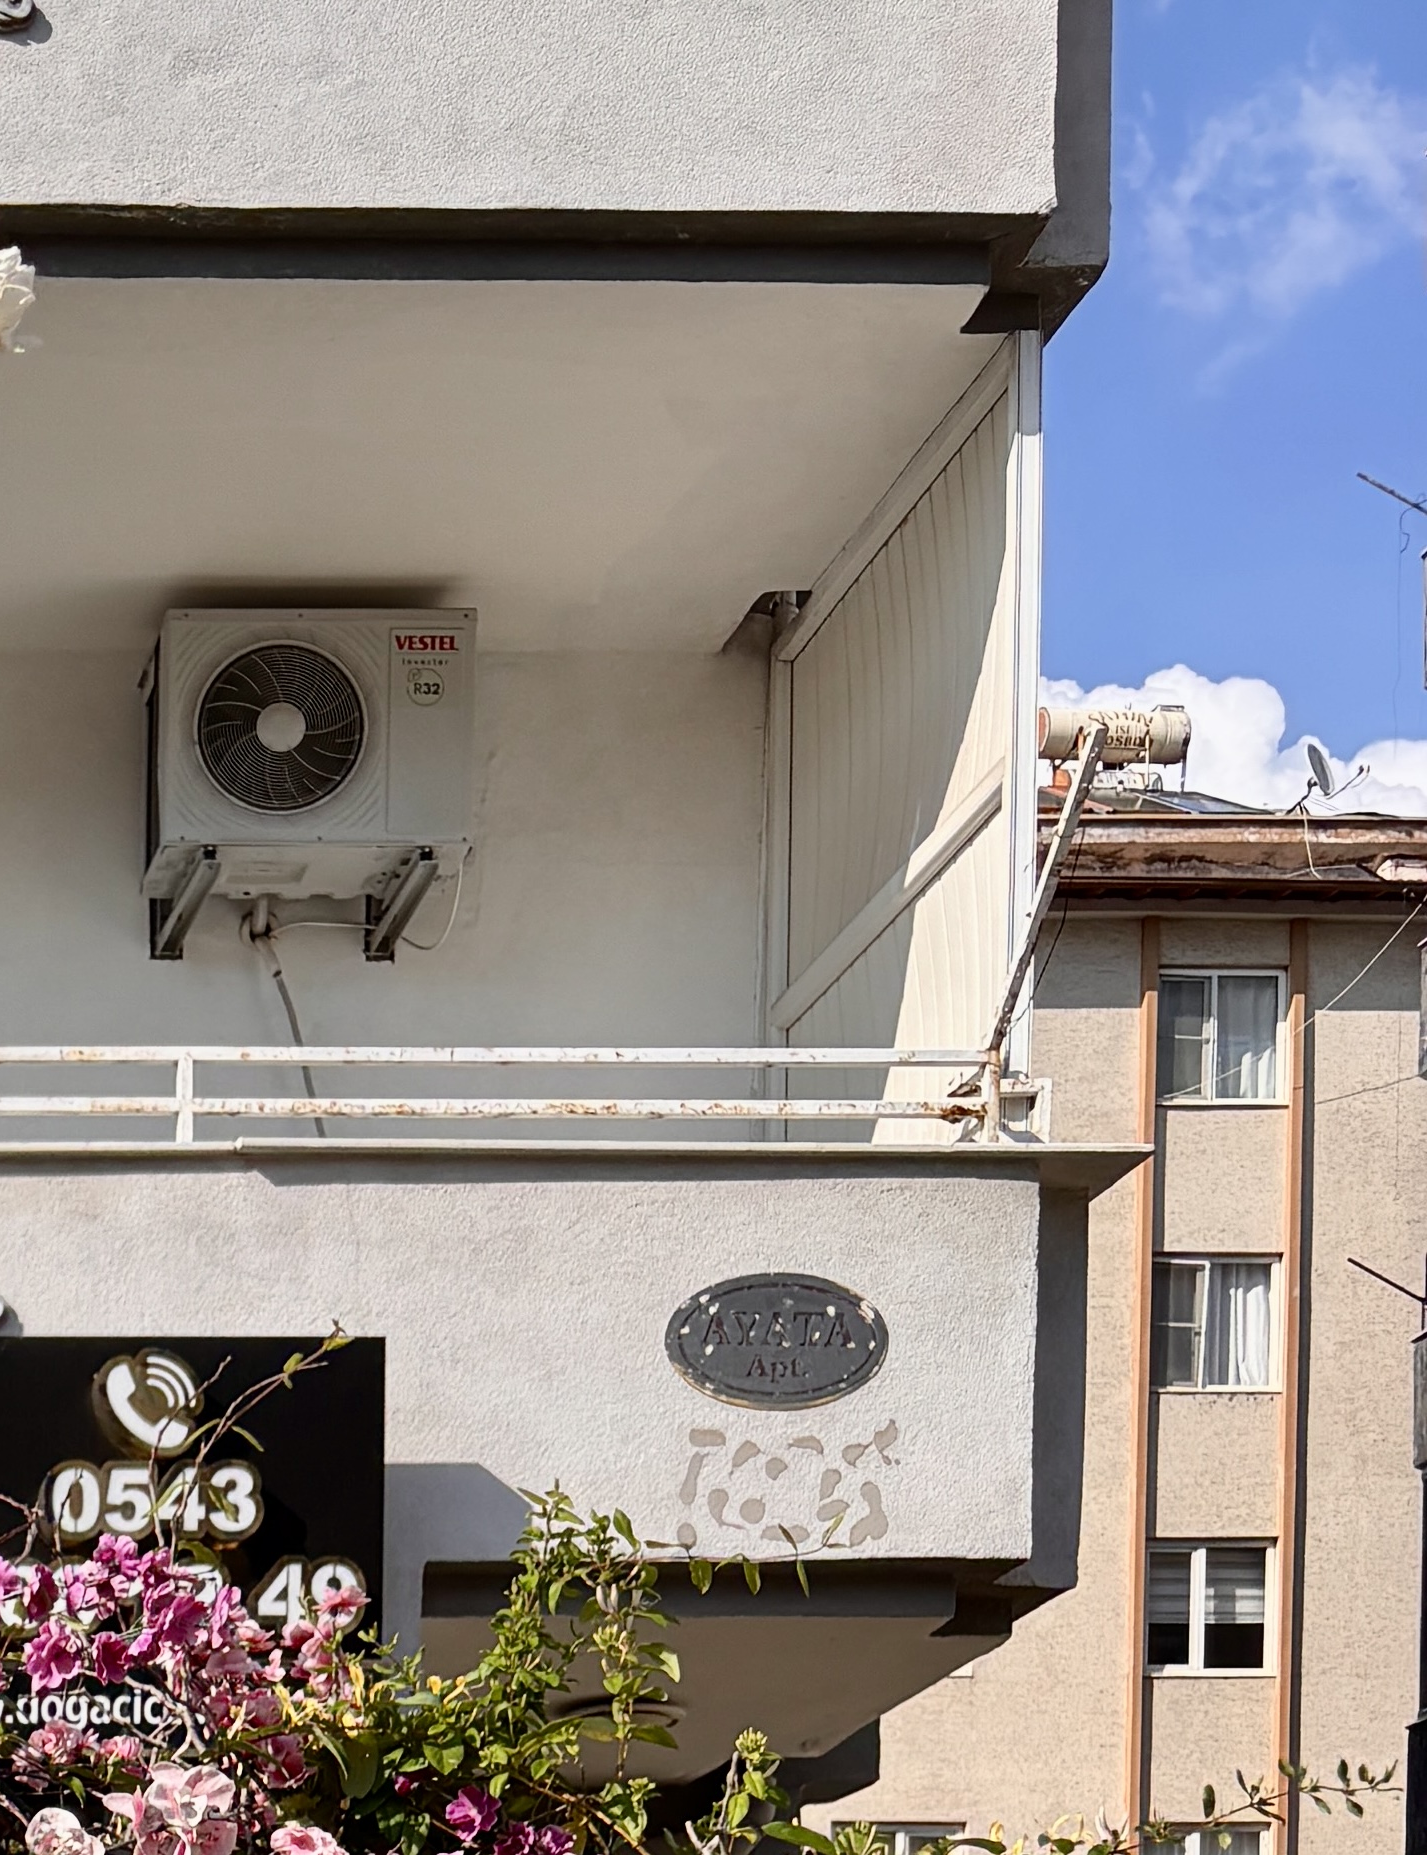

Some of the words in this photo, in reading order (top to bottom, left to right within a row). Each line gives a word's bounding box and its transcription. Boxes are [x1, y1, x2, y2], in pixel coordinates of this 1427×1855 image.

[395, 635, 459, 651] VESTEL
[413, 682, 440, 695] R32
[700, 1311, 856, 1348] AYATA
[50, 1464, 259, 1535] 0543
